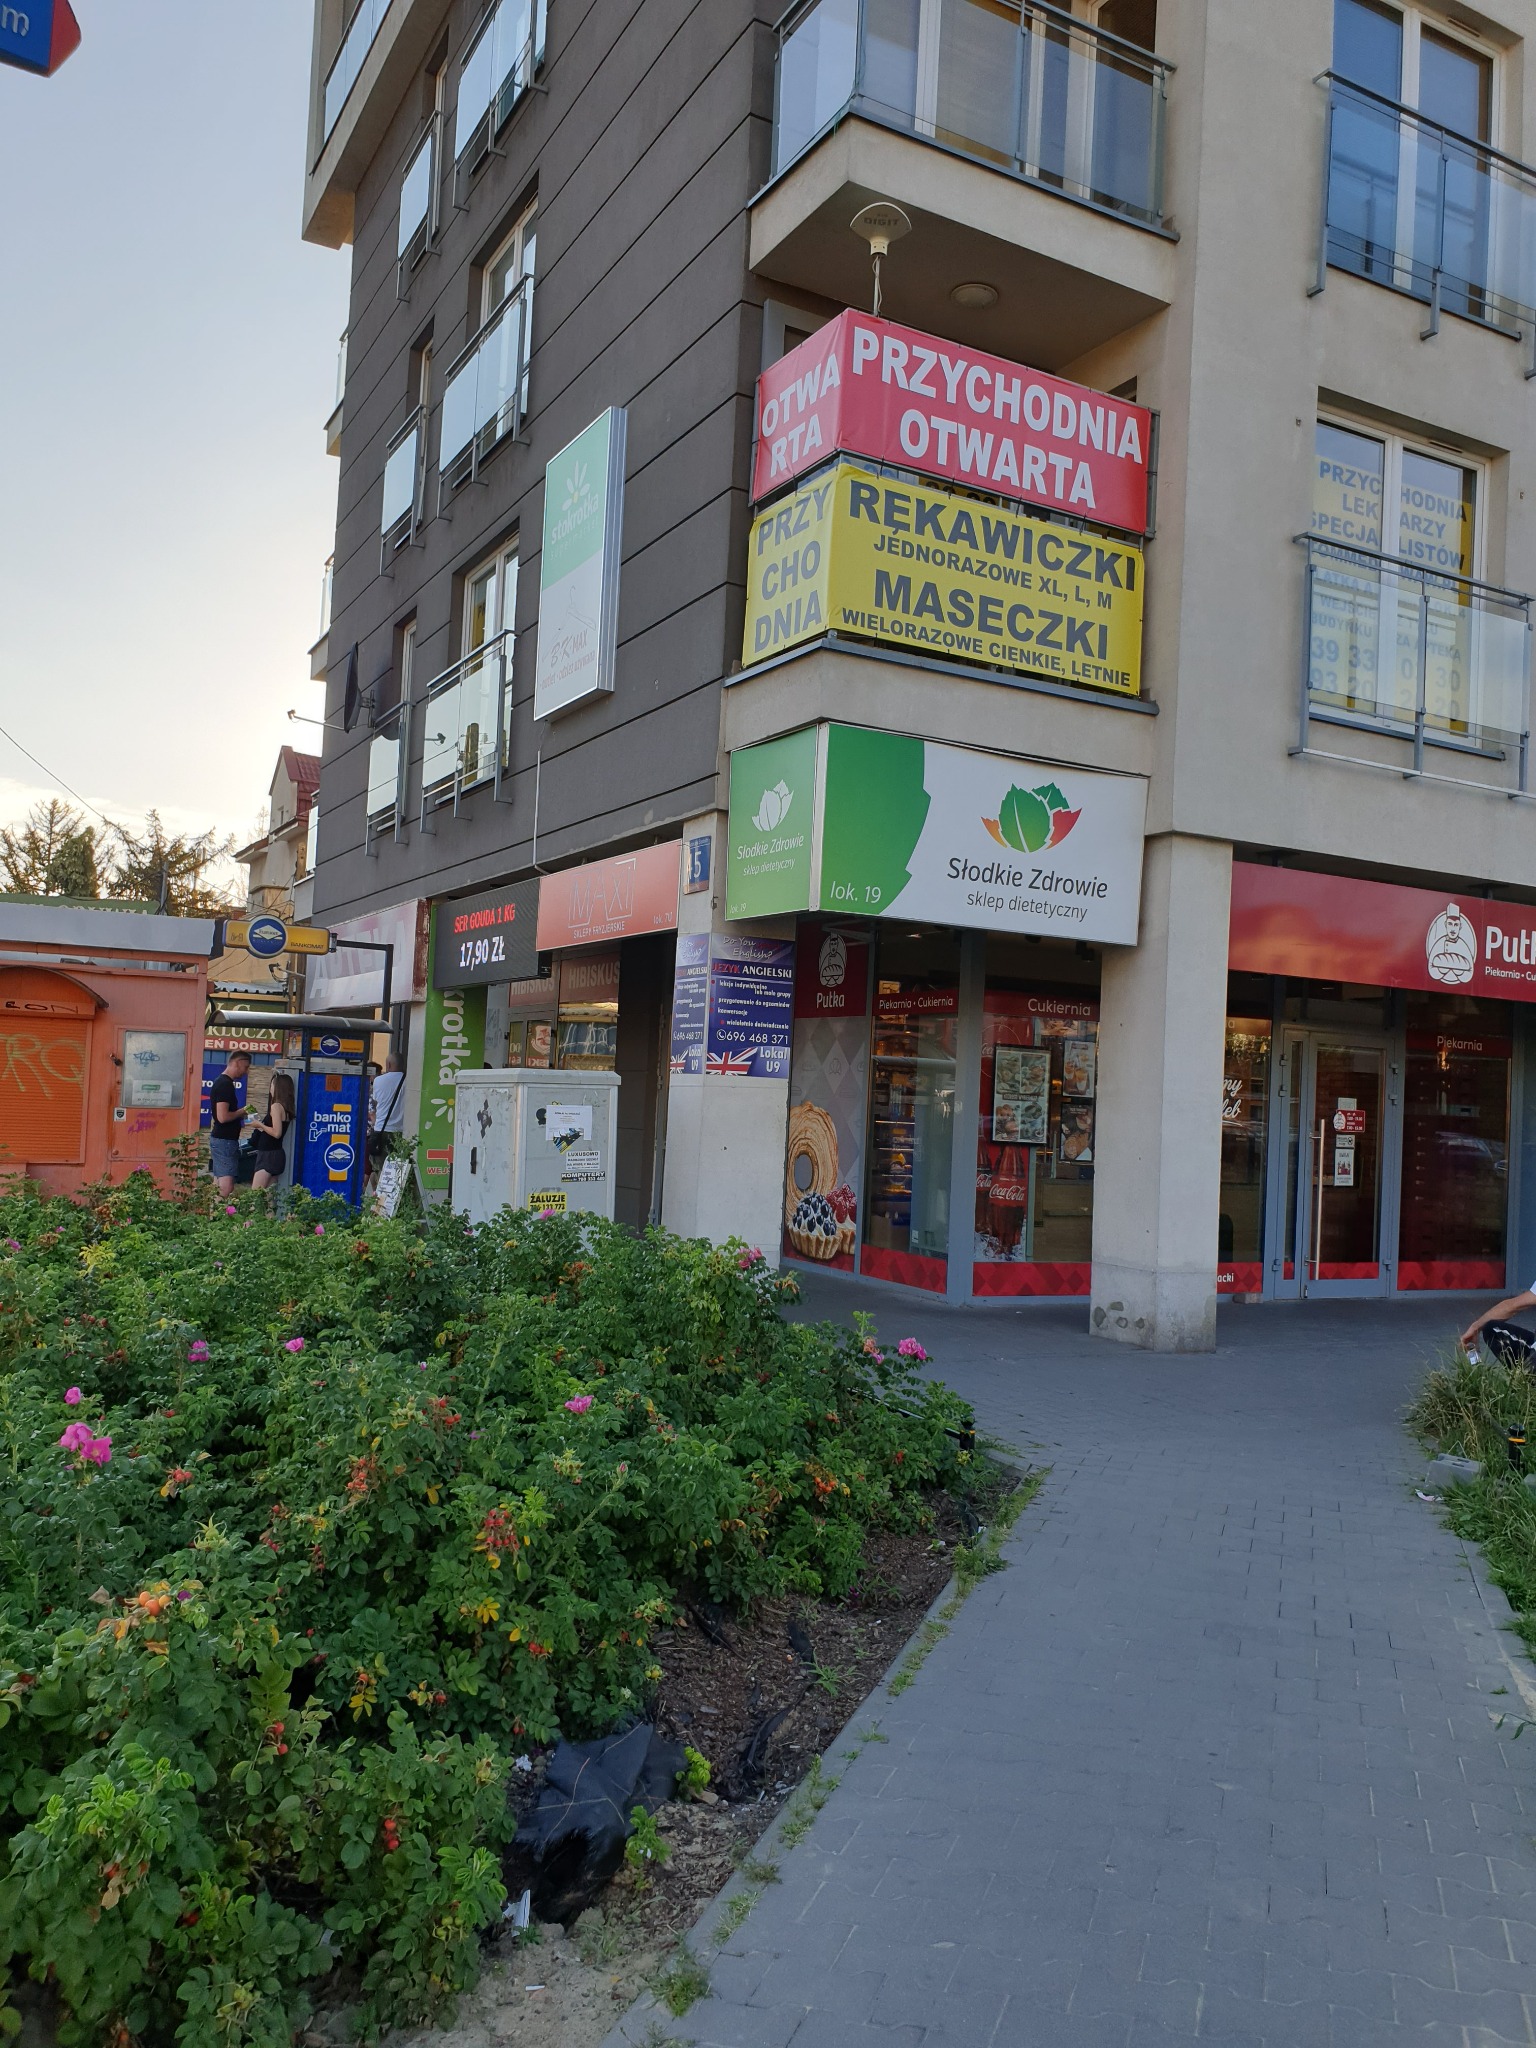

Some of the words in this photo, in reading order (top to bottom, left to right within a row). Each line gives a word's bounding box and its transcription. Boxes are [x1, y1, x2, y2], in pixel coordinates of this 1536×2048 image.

[761, 353, 841, 438] OTWA
[852, 326, 1142, 464] PRZYCHODNIA
[769, 413, 823, 478] RTA
[899, 409, 1096, 509] OTWARTA
[551, 492, 599, 545] stokrotka
[757, 481, 830, 556] PRZY
[849, 479, 1136, 591] RĘKAWICZKI
[761, 540, 821, 600] CHO
[873, 533, 1032, 590] JEDNORAZOWE
[1038, 575, 1069, 603] XL,
[1074, 585, 1091, 607] L,
[1098, 590, 1112, 610] M
[755, 591, 822, 653] DNIA
[874, 568, 1109, 661] MASECZKI
[842, 607, 983, 655] WIELORAZOWE
[988, 642, 1066, 676] CIENKIE,
[1070, 659, 1131, 688] LETNIE
[736, 841, 769, 860] Słodkie
[769, 832, 804, 854] Zdrowie
[743, 864, 760, 876] sklep
[760, 858, 796, 873] dietetyczny
[947, 856, 1023, 888] Słodkie
[1028, 867, 1109, 899] Zdrowie
[829, 881, 860, 902] lok.
[864, 885, 882, 904] 19
[454, 915, 468, 934] SER
[470, 908, 495, 930] GOUDA
[497, 906, 502, 924] 1
[503, 903, 516, 922] KG
[966, 890, 1005, 912] sklep
[1007, 895, 1088, 922] dietetyczny
[291, 942, 324, 950] BANKOMAT
[459, 938, 489, 971] 17,90
[491, 935, 506, 962] ZŁ
[732, 947, 773, 959] English?
[742, 965, 792, 979] ANGIELSKI
[1485, 965, 1520, 980] Piekarnia
[816, 991, 845, 1009] Putka
[878, 998, 912, 1010] Piekarnia
[917, 996, 953, 1008] Cukiernia
[1027, 998, 1091, 1016] Cukiernia
[229, 1040, 279, 1052] DOBRY
[726, 1030, 746, 1042] 696
[748, 1033, 768, 1044] 468
[771, 1034, 789, 1045] 371
[1436, 1035, 1483, 1051] Piekarnia
[760, 1046, 788, 1060] Lokal
[765, 1060, 781, 1073] U9
[313, 1111, 352, 1123] banko
[327, 1123, 351, 1133] mat
[530, 1193, 566, 1204] ŻALUZJE
